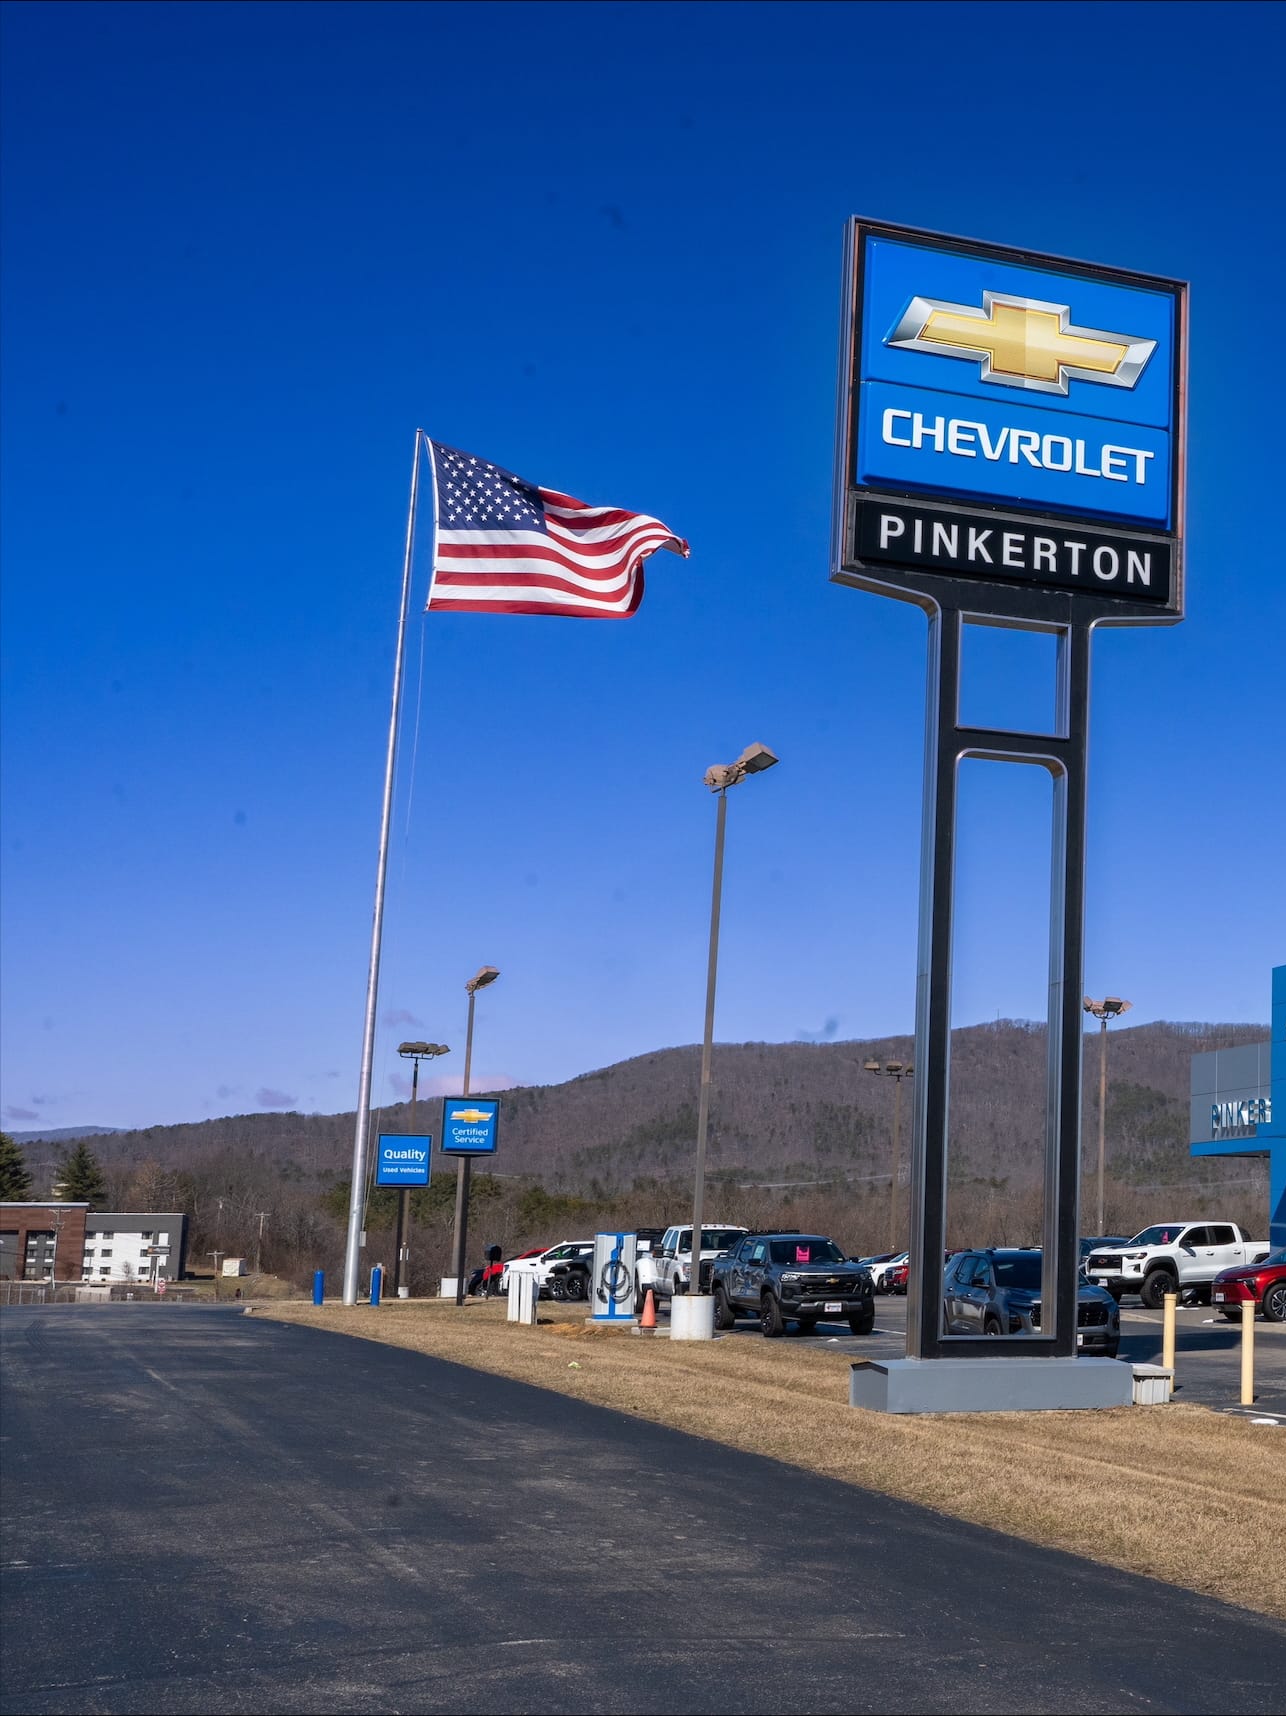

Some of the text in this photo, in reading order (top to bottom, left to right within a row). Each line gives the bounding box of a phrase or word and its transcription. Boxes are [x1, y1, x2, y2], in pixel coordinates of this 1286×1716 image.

[882, 408, 1154, 484] CHEVROLET
[880, 514, 1151, 586] PINKERTON
[1212, 1098, 1271, 1129] PINKER
[451, 1127, 489, 1136] Certified
[454, 1135, 486, 1144] Service
[384, 1149, 426, 1162] Quality
